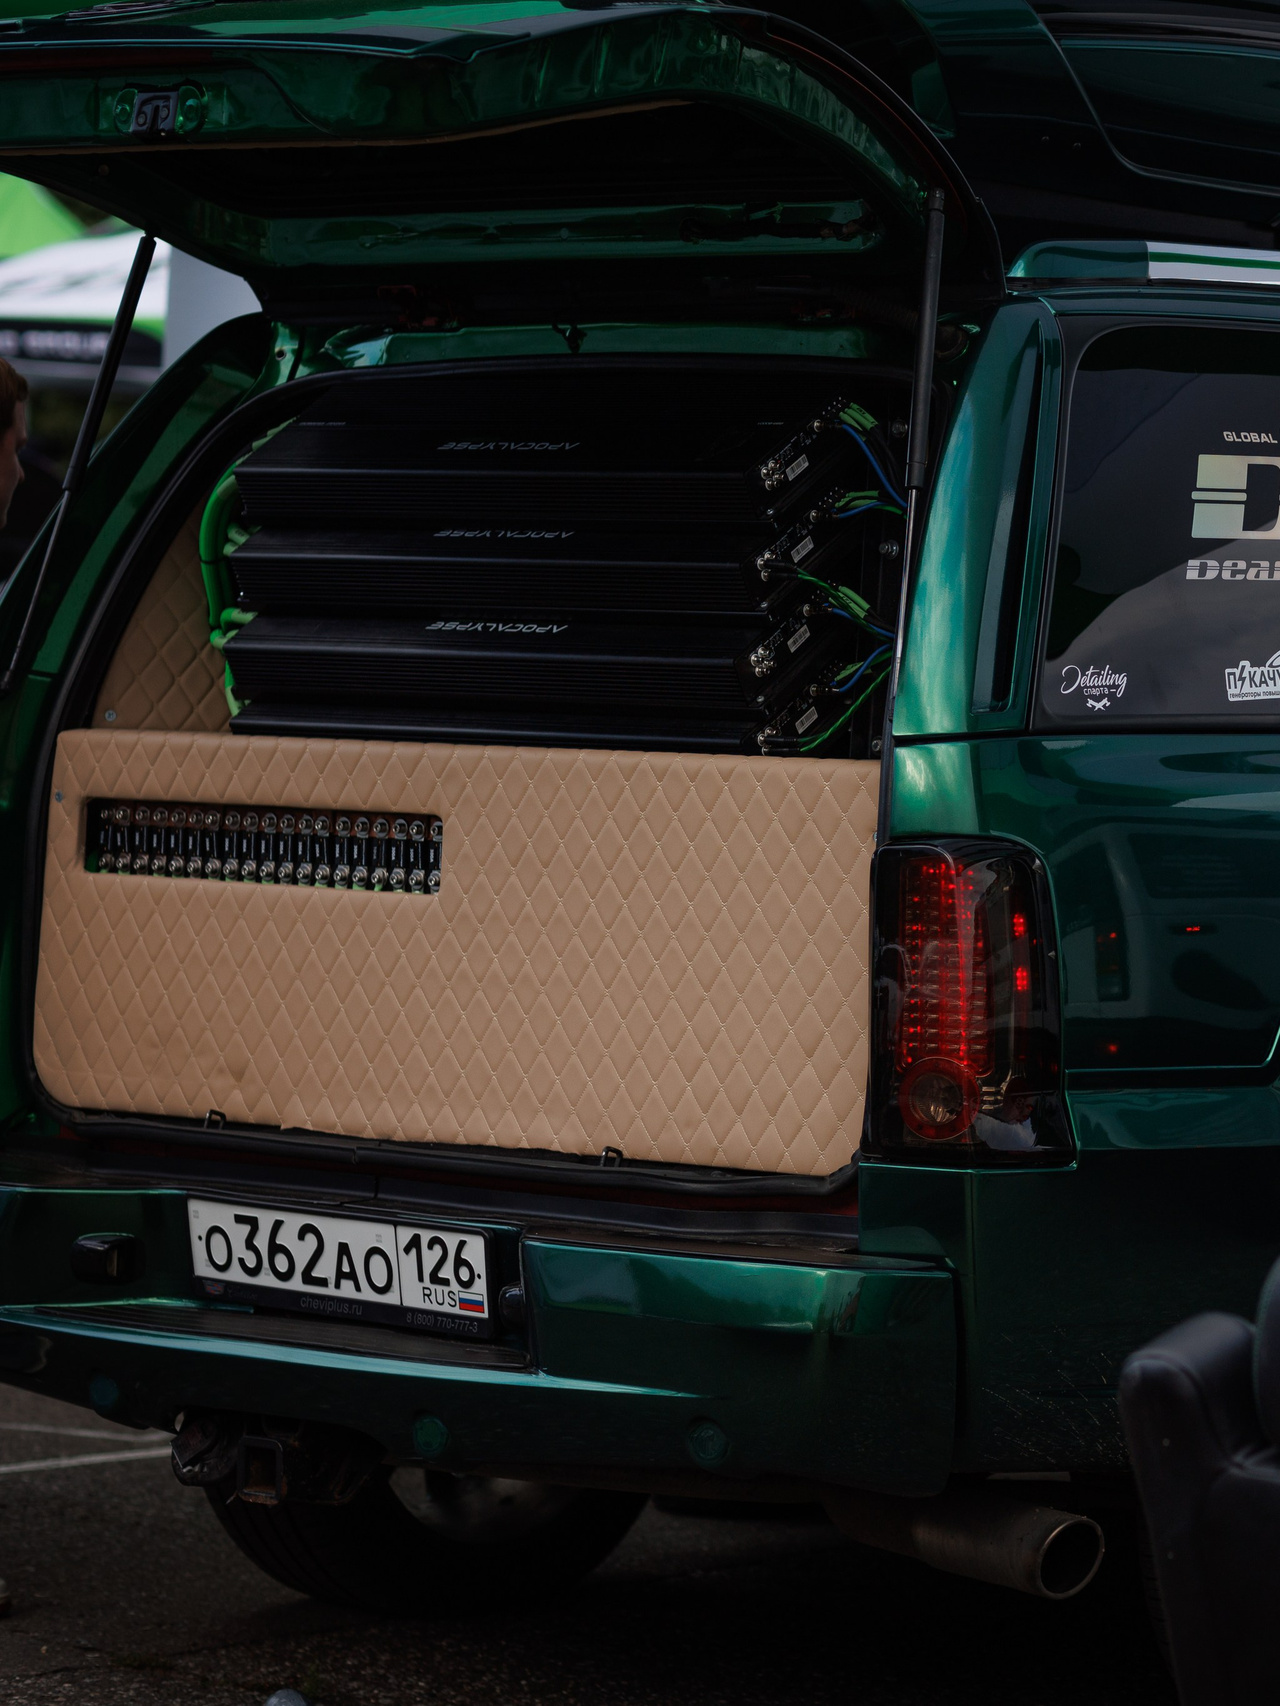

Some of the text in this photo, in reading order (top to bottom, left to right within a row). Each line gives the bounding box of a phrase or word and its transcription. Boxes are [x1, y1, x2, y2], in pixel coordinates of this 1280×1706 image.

[1222, 431, 1278, 444] GLOBAL
[436, 441, 581, 451] APOCALYPSE
[432, 529, 576, 539] APOCALYPSE
[424, 621, 569, 634] APOCALYPSE
[1061, 664, 1128, 698] Detailing
[402, 1233, 476, 1289] 126
[422, 1286, 458, 1308] RUS
[300, 1294, 363, 1317] cheviplus.ru
[406, 1311, 412, 1323] 8
[413, 1311, 435, 1327] (800)
